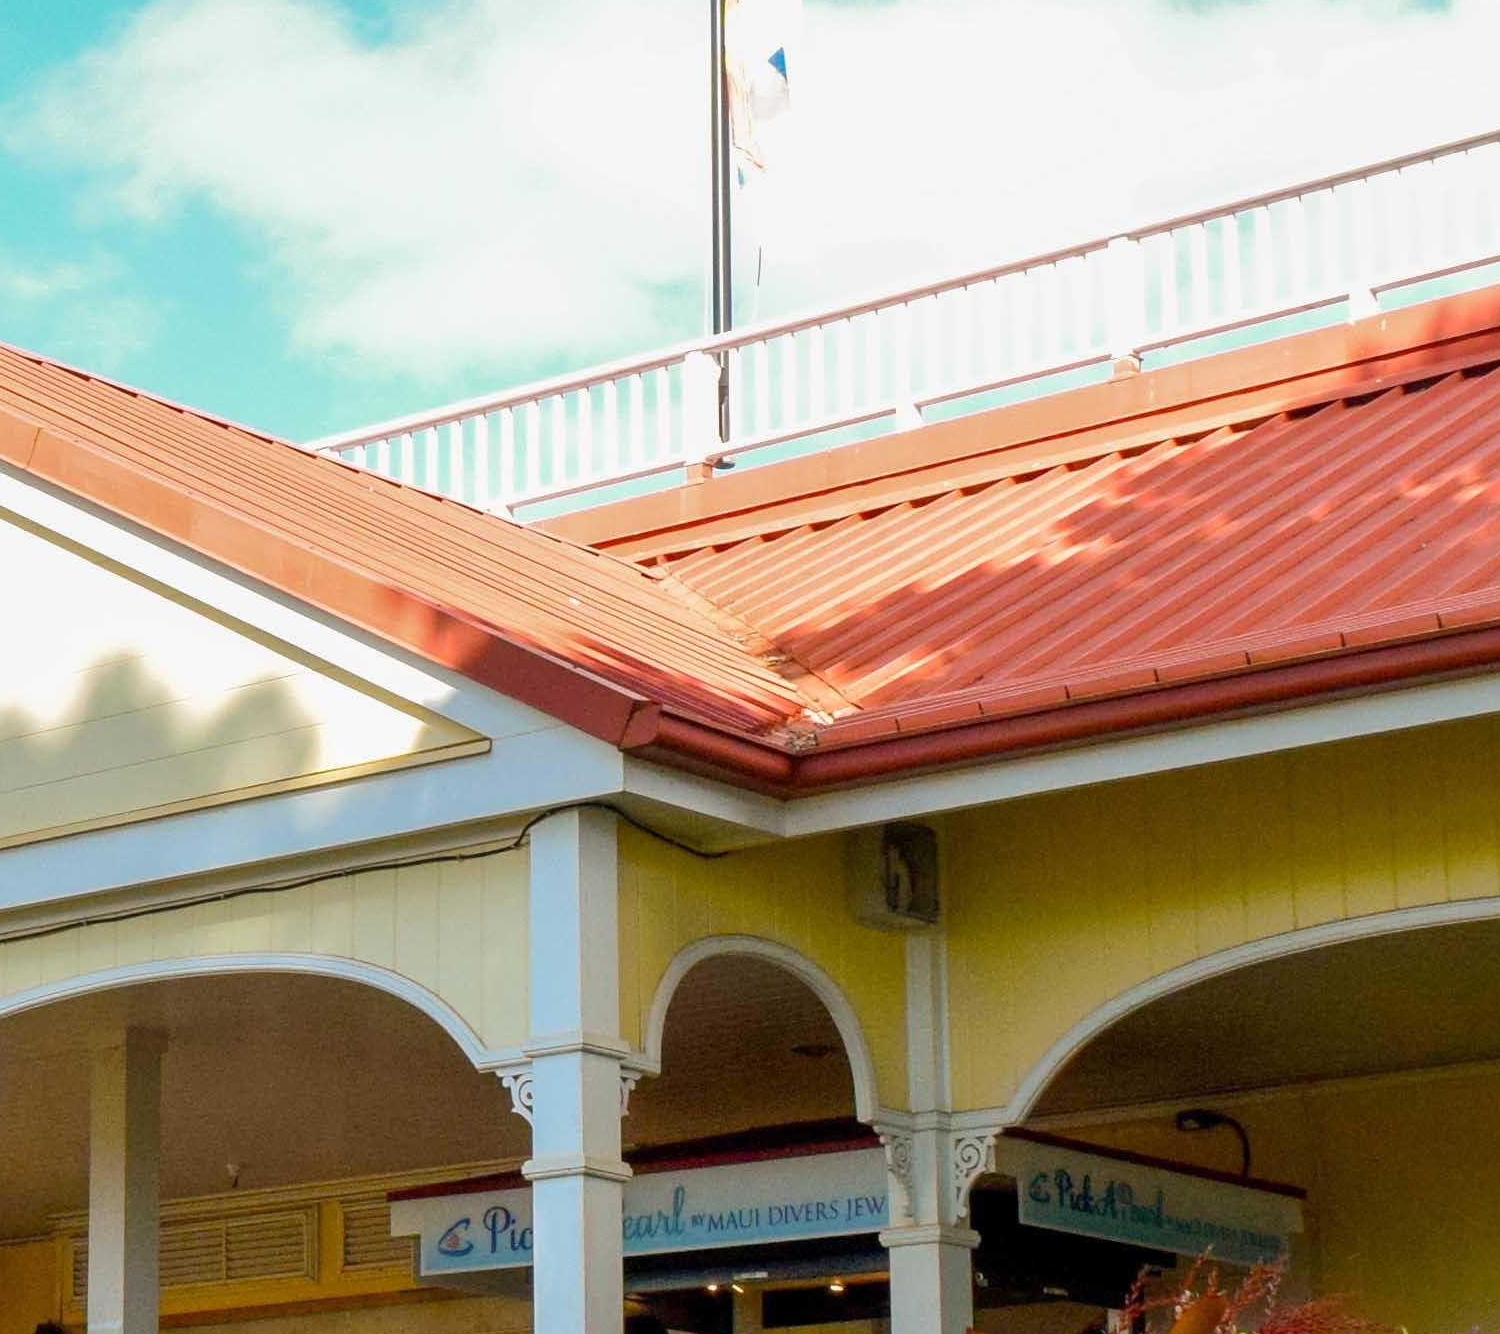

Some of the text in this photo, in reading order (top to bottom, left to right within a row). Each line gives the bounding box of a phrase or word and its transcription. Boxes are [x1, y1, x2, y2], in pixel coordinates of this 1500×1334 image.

[483, 1205, 534, 1254] Pic
[623, 1184, 686, 1241] earl
[706, 1208, 760, 1233] MAUI
[768, 1199, 840, 1227] DIVERS
